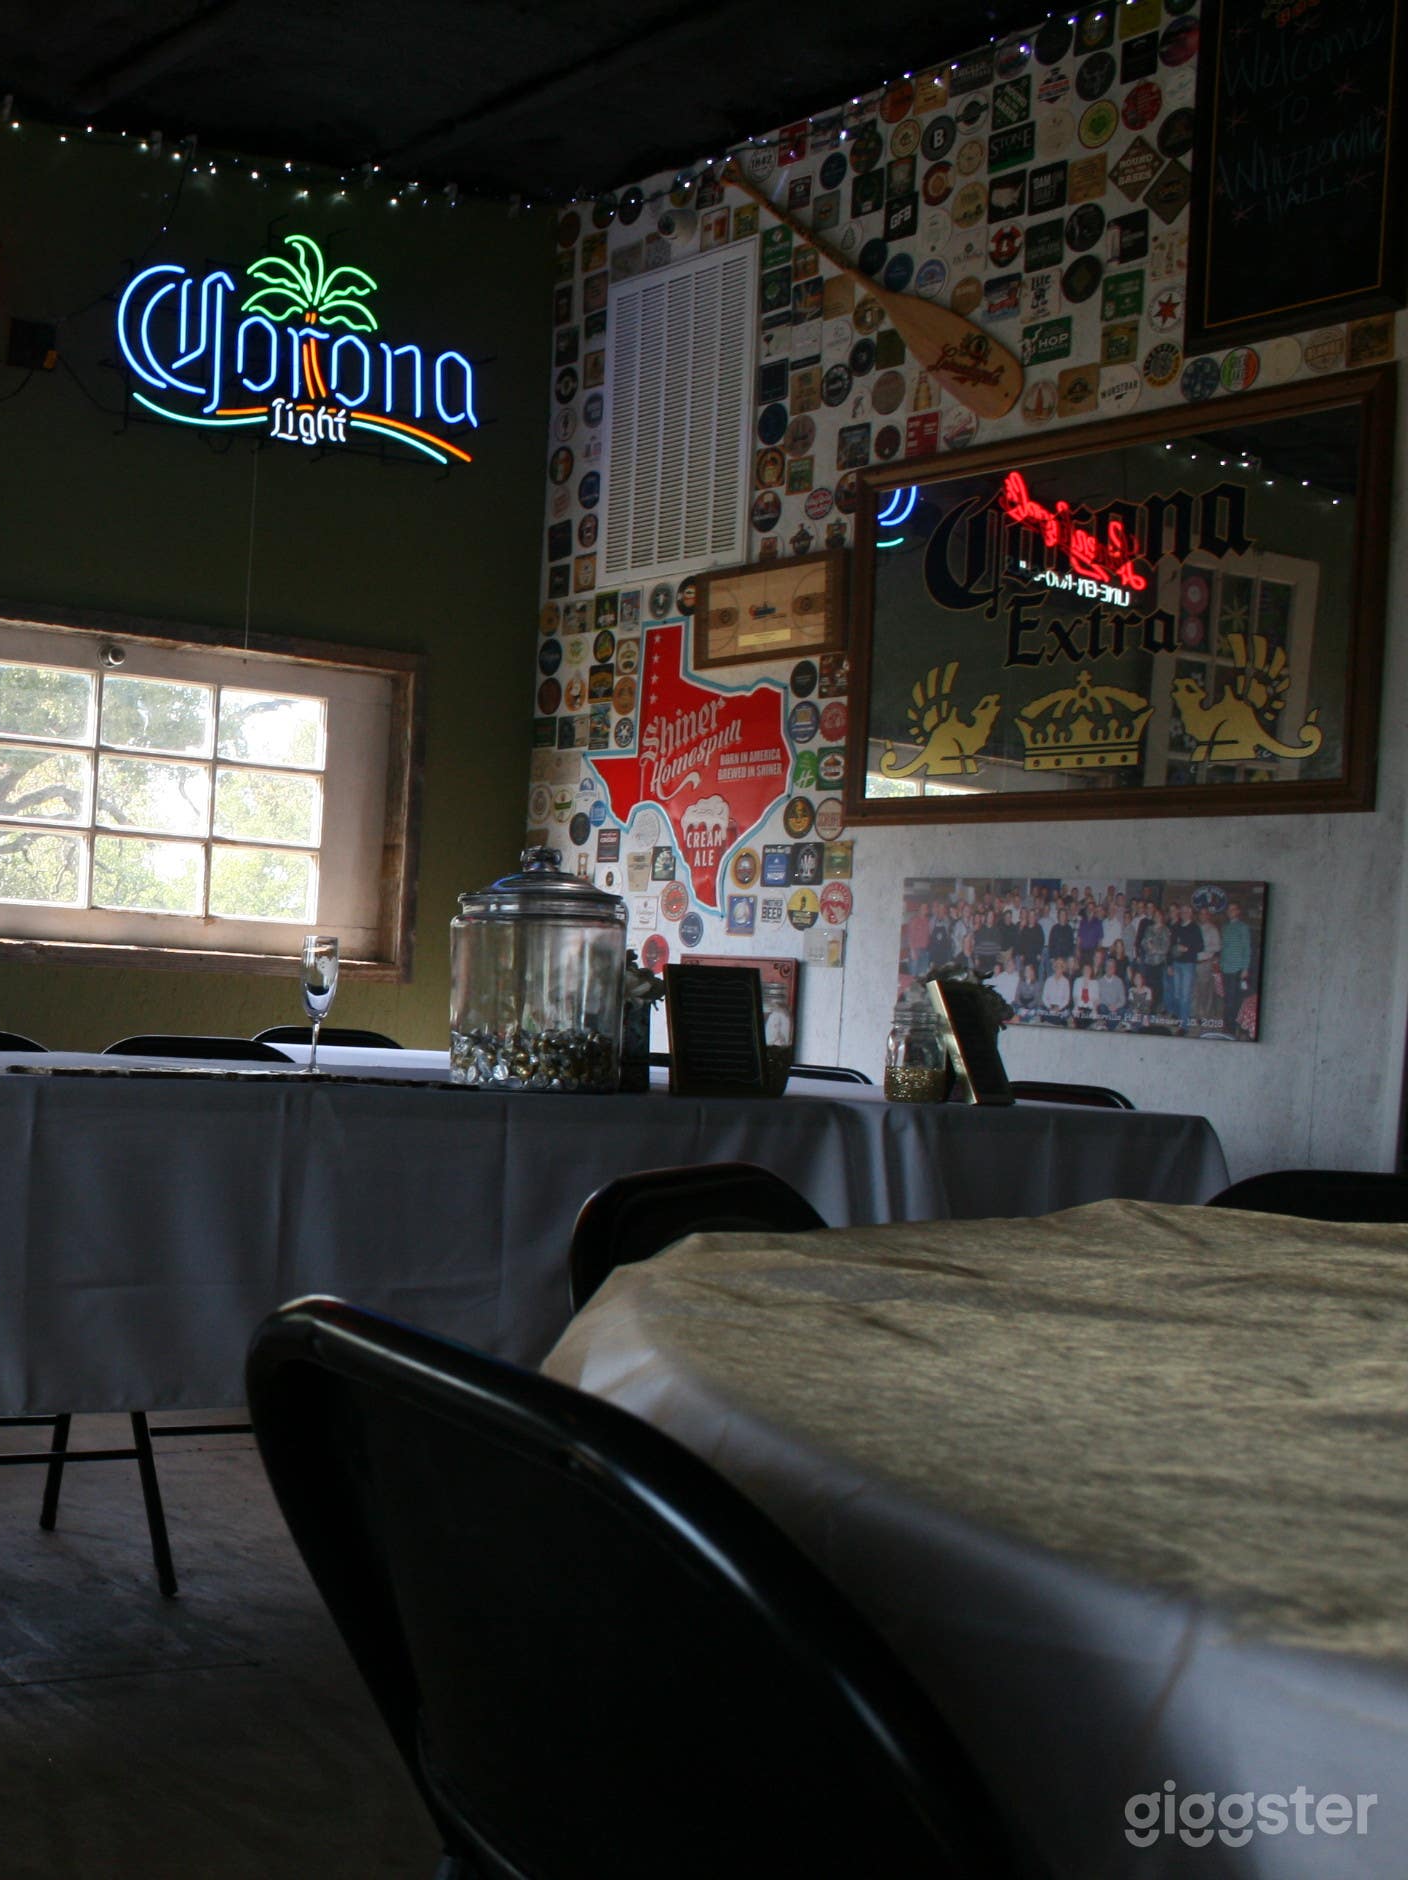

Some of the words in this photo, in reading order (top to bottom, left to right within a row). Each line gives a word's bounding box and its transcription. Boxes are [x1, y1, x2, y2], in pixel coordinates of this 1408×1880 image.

[117, 265, 479, 428] Corona
[269, 398, 349, 445] Light
[924, 482, 1256, 619] Corona
[1002, 590, 1182, 669] Extra
[640, 696, 727, 765] Shiner
[750, 748, 781, 762] AMERICA
[717, 768, 746, 781] BREWED
[756, 763, 782, 778] SHINER
[687, 831, 723, 848] CREAM
[694, 850, 714, 867] ALE
[761, 907, 782, 920] BEER
